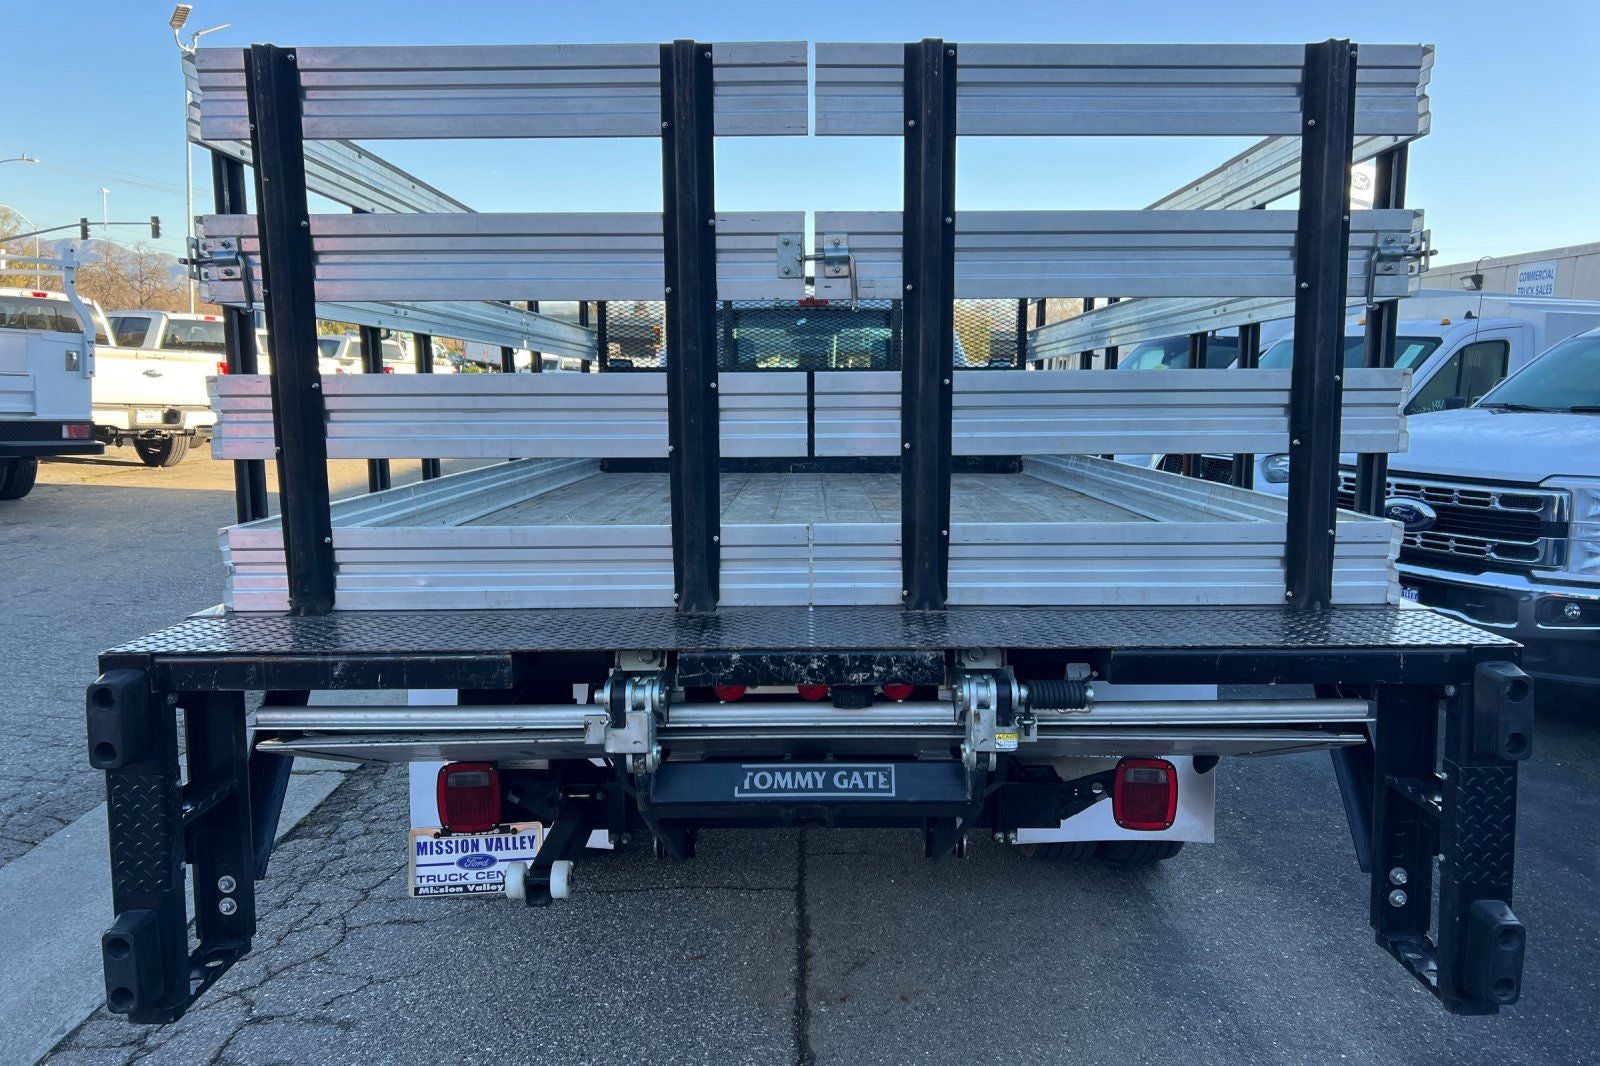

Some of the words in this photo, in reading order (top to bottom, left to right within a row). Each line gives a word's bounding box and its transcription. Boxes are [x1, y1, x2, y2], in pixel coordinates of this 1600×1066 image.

[1519, 268, 1554, 282] COMMERCIAL
[1517, 286, 1534, 295] TRUCK
[1535, 284, 1553, 295] SALES
[1400, 590, 1418, 600] ALLEY
[743, 771, 827, 790] TOMMY
[833, 771, 890, 789] GATE
[416, 838, 480, 856] MISSION
[485, 835, 536, 852] VALLEY
[416, 872, 469, 883] TRUCK
[475, 870, 506, 880] CEN
[467, 883, 504, 892] Valley
